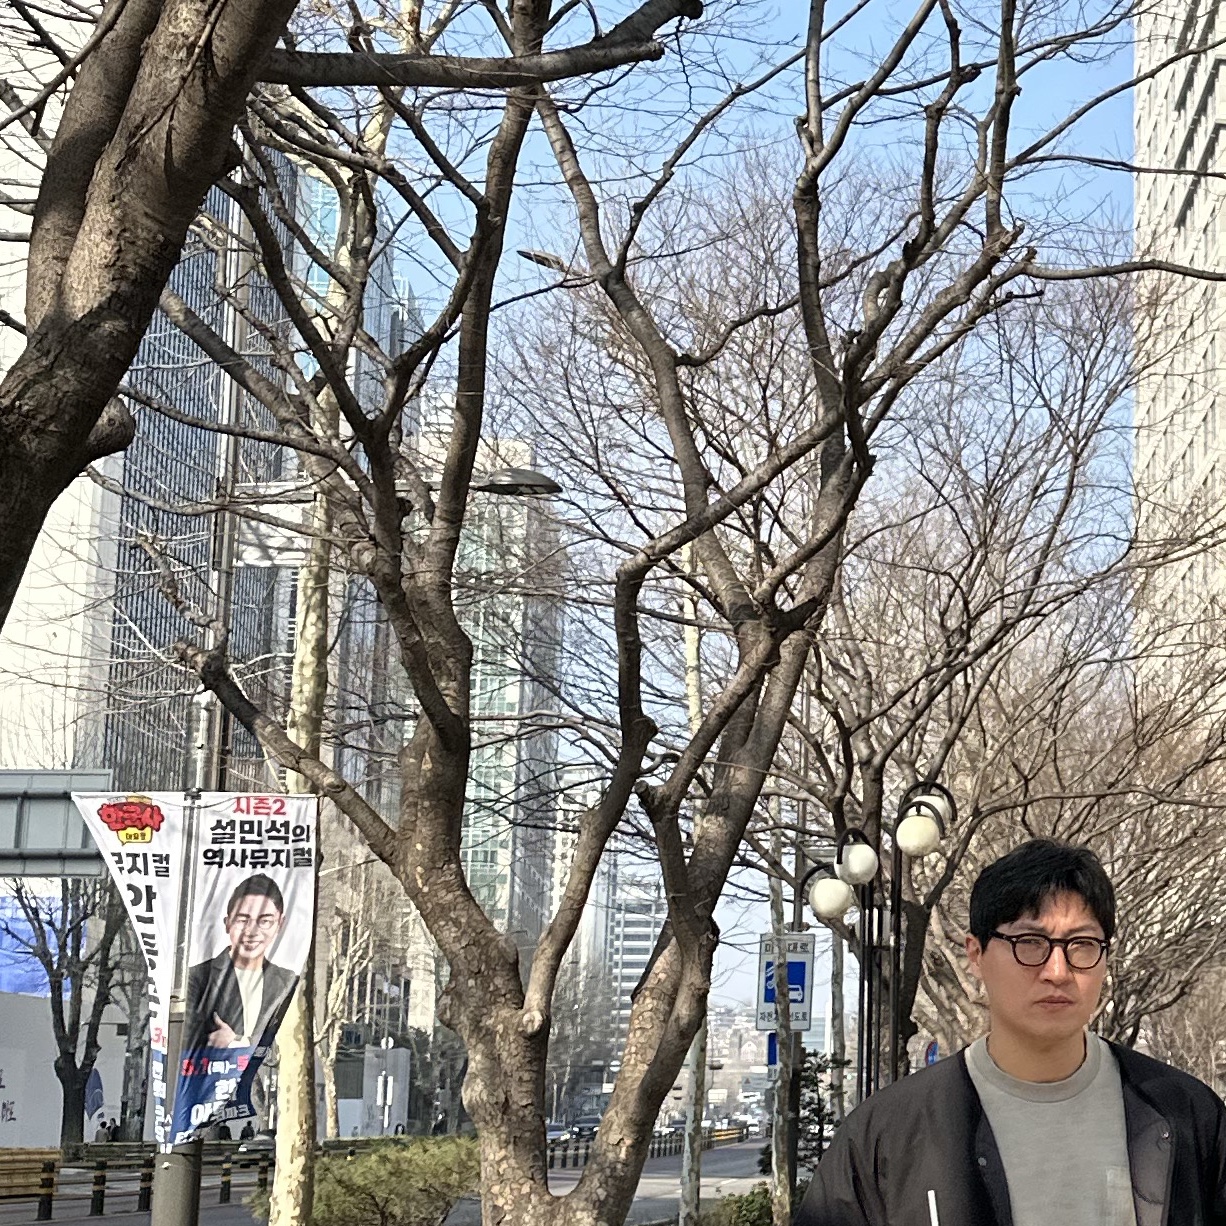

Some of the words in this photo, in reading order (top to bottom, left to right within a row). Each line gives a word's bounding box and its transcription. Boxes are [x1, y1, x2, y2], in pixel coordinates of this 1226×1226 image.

[233, 796, 286, 816] 시즌2
[209, 819, 311, 845] 설민석의
[202, 847, 313, 869] 역사뮤지컬
